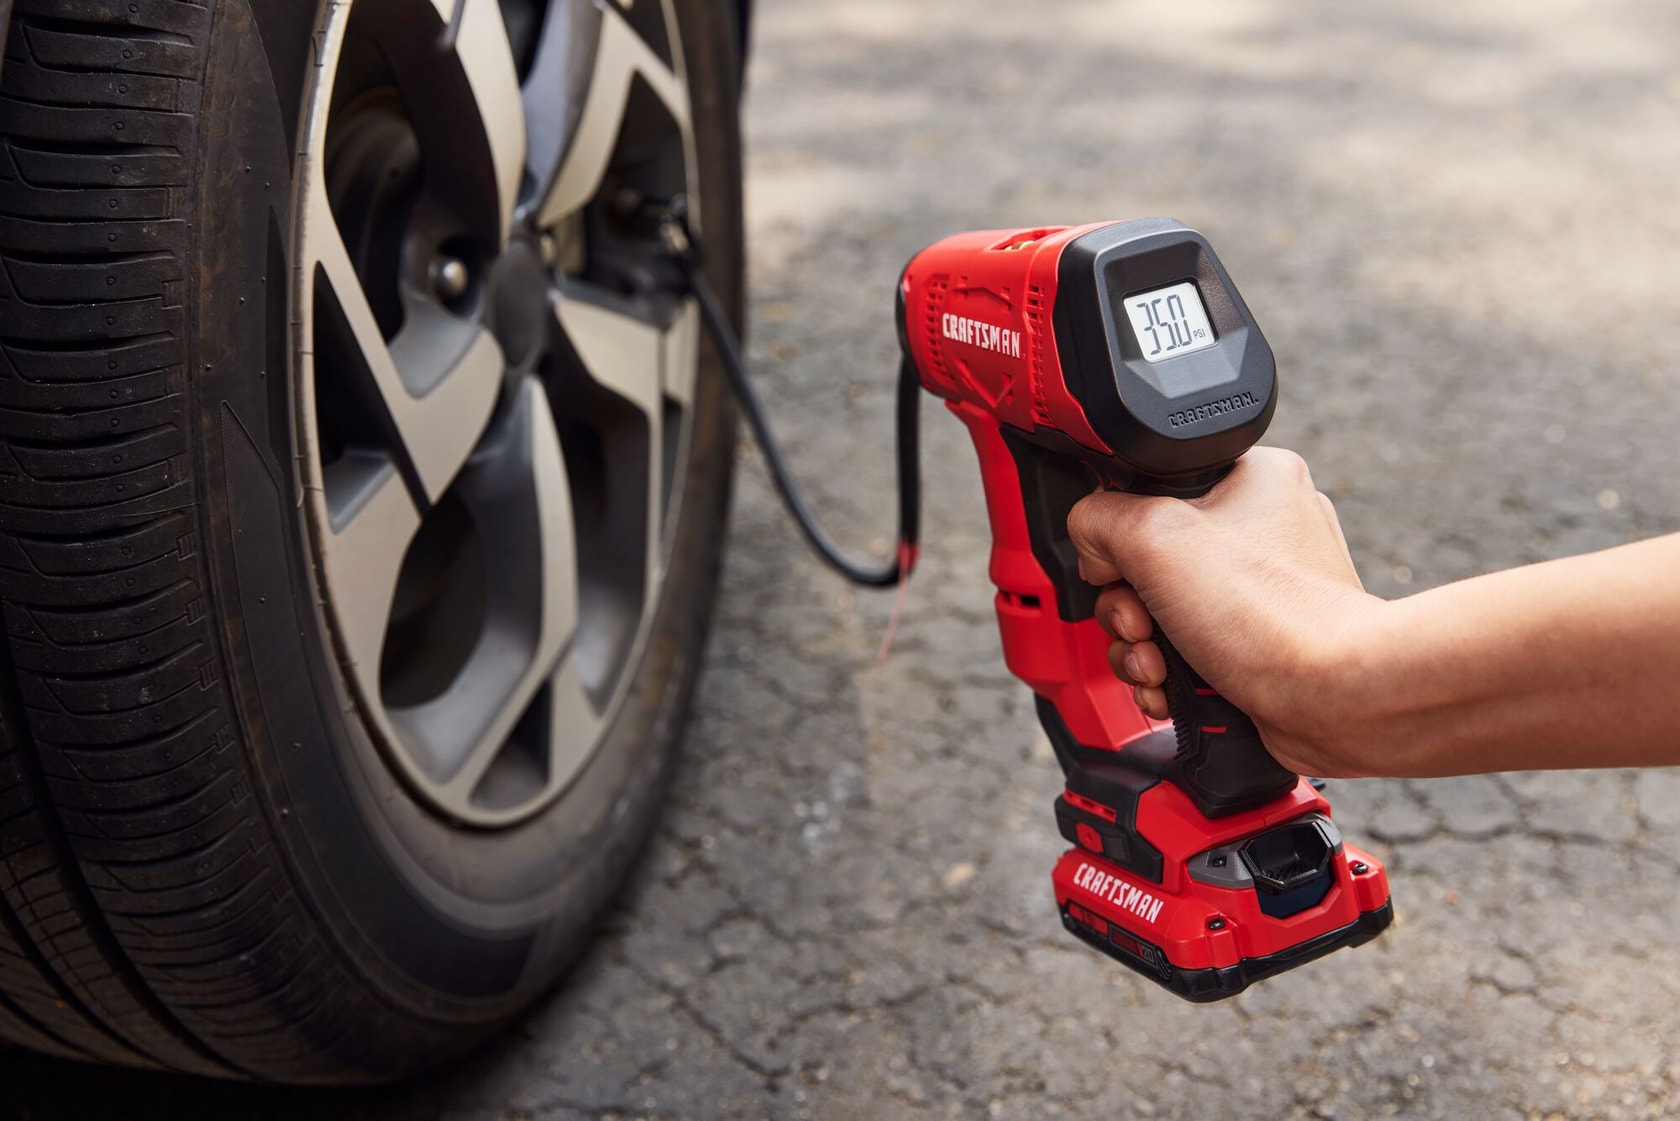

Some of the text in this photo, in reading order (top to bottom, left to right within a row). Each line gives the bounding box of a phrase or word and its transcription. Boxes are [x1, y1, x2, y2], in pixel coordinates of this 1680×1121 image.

[942, 312, 1021, 359] CRAFTSMAN
[1193, 328, 1206, 339] PSI
[1073, 862, 1164, 924] CRAFTSMAN
